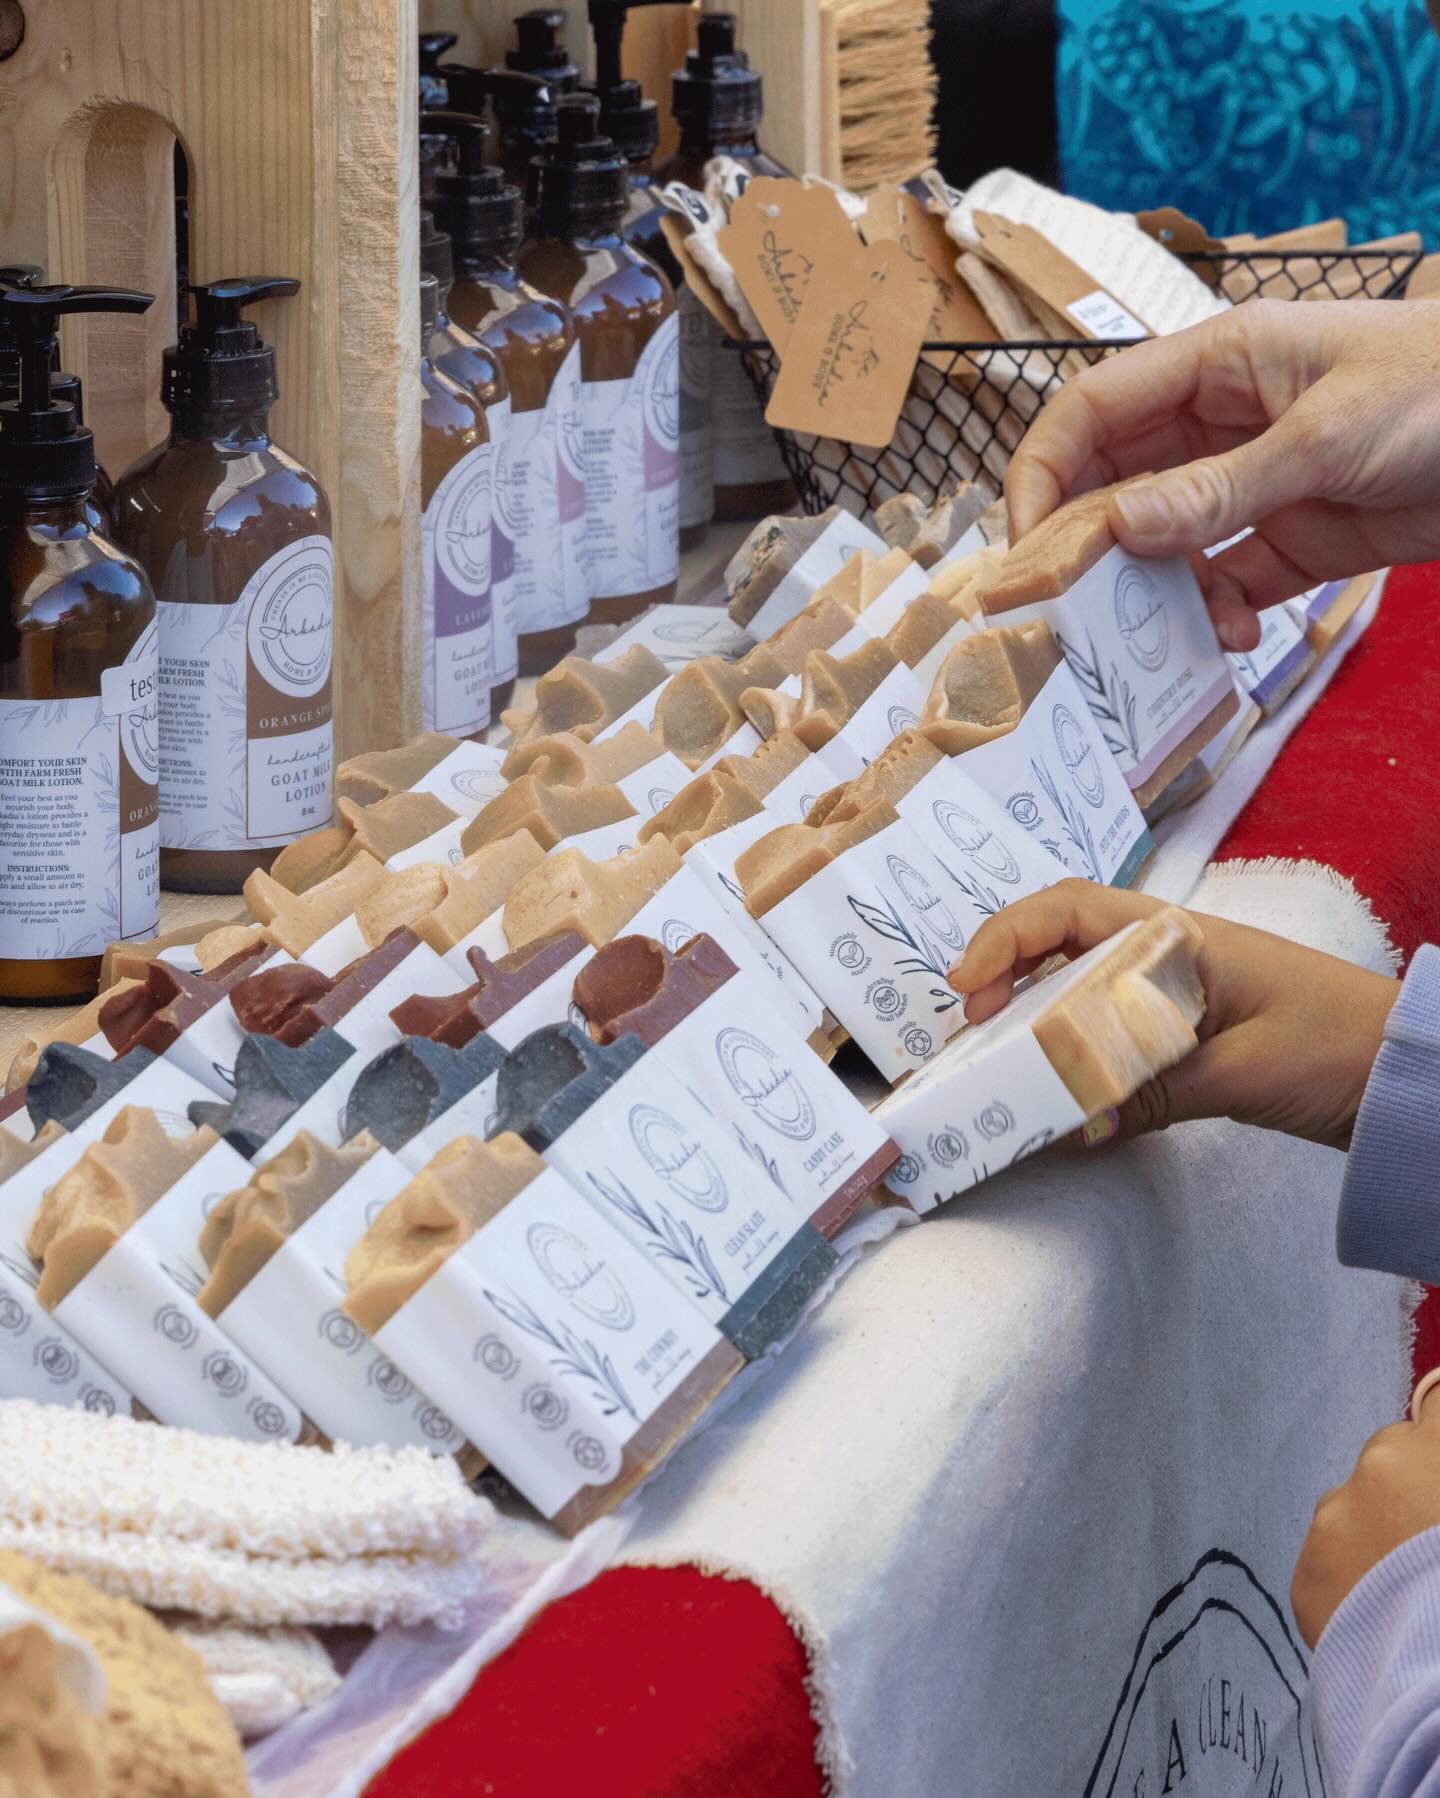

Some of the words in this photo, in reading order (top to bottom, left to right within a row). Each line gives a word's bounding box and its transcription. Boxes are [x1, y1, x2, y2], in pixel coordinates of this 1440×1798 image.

[260, 711, 313, 729] ORANGE
[0, 759, 34, 768] OMFORT
[39, 758, 64, 768] YOUR
[65, 756, 87, 766] SKIN
[25, 769, 51, 777] FARM
[53, 767, 81, 777] FRESH
[271, 769, 309, 787] GOAT
[0, 778, 20, 787] OAT
[23, 779, 46, 788] MILK
[48, 777, 84, 788] LOTION.
[286, 782, 327, 803] LOTION
[0, 873, 15, 882] pply
[7, 864, 71, 873] INSTRUCTIONS:
[829, 931, 858, 958] sustainably
[851, 956, 873, 977] sourced
[863, 976, 895, 1005] handcrafted
[876, 1013, 895, 1023] small
[803, 1149, 826, 1173] CANDY
[822, 1131, 845, 1156] CANE
[1162, 1718, 1187, 1795] A
[1199, 1672, 1268, 1782] CLEAN
